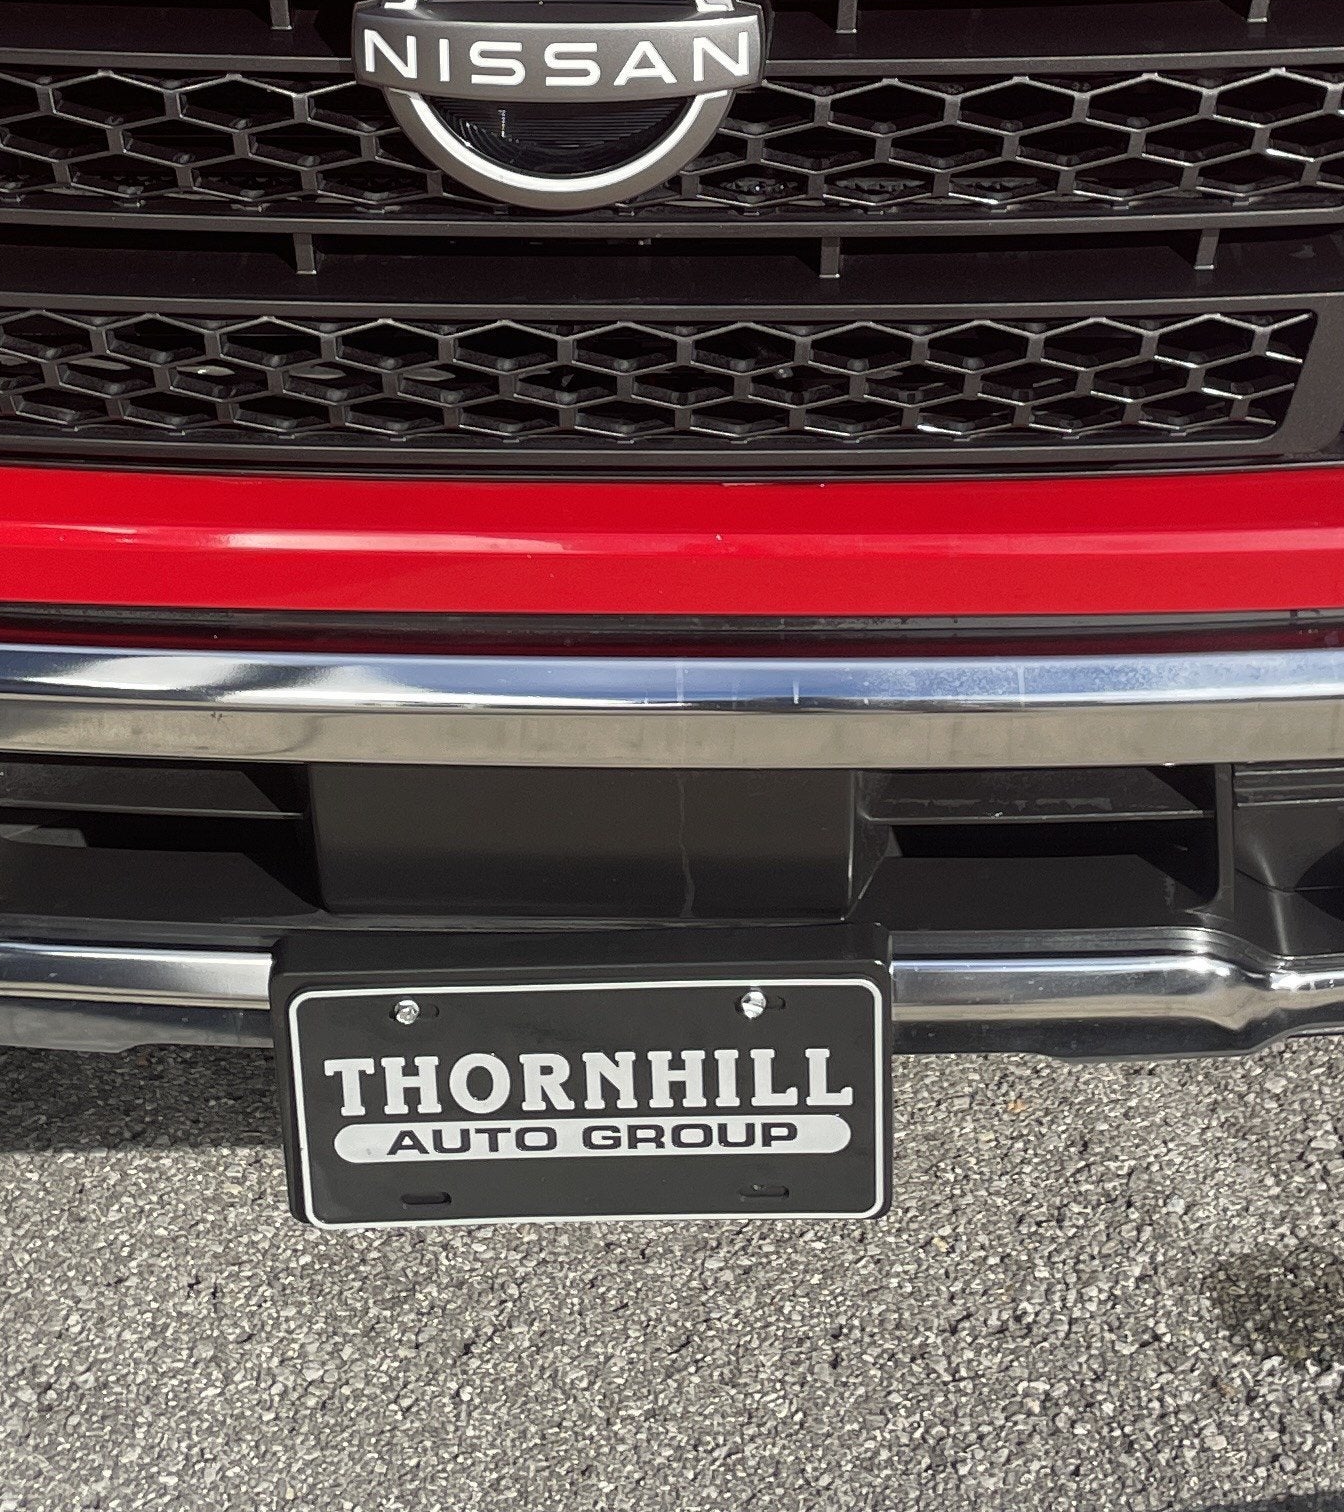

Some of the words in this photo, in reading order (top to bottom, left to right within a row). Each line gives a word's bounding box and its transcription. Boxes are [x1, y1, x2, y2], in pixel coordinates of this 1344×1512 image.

[363, 29, 749, 87] NISSAN
[324, 1048, 854, 1117] THORNHILL
[386, 1125, 558, 1155] AUTO
[581, 1121, 799, 1151] GROUP
